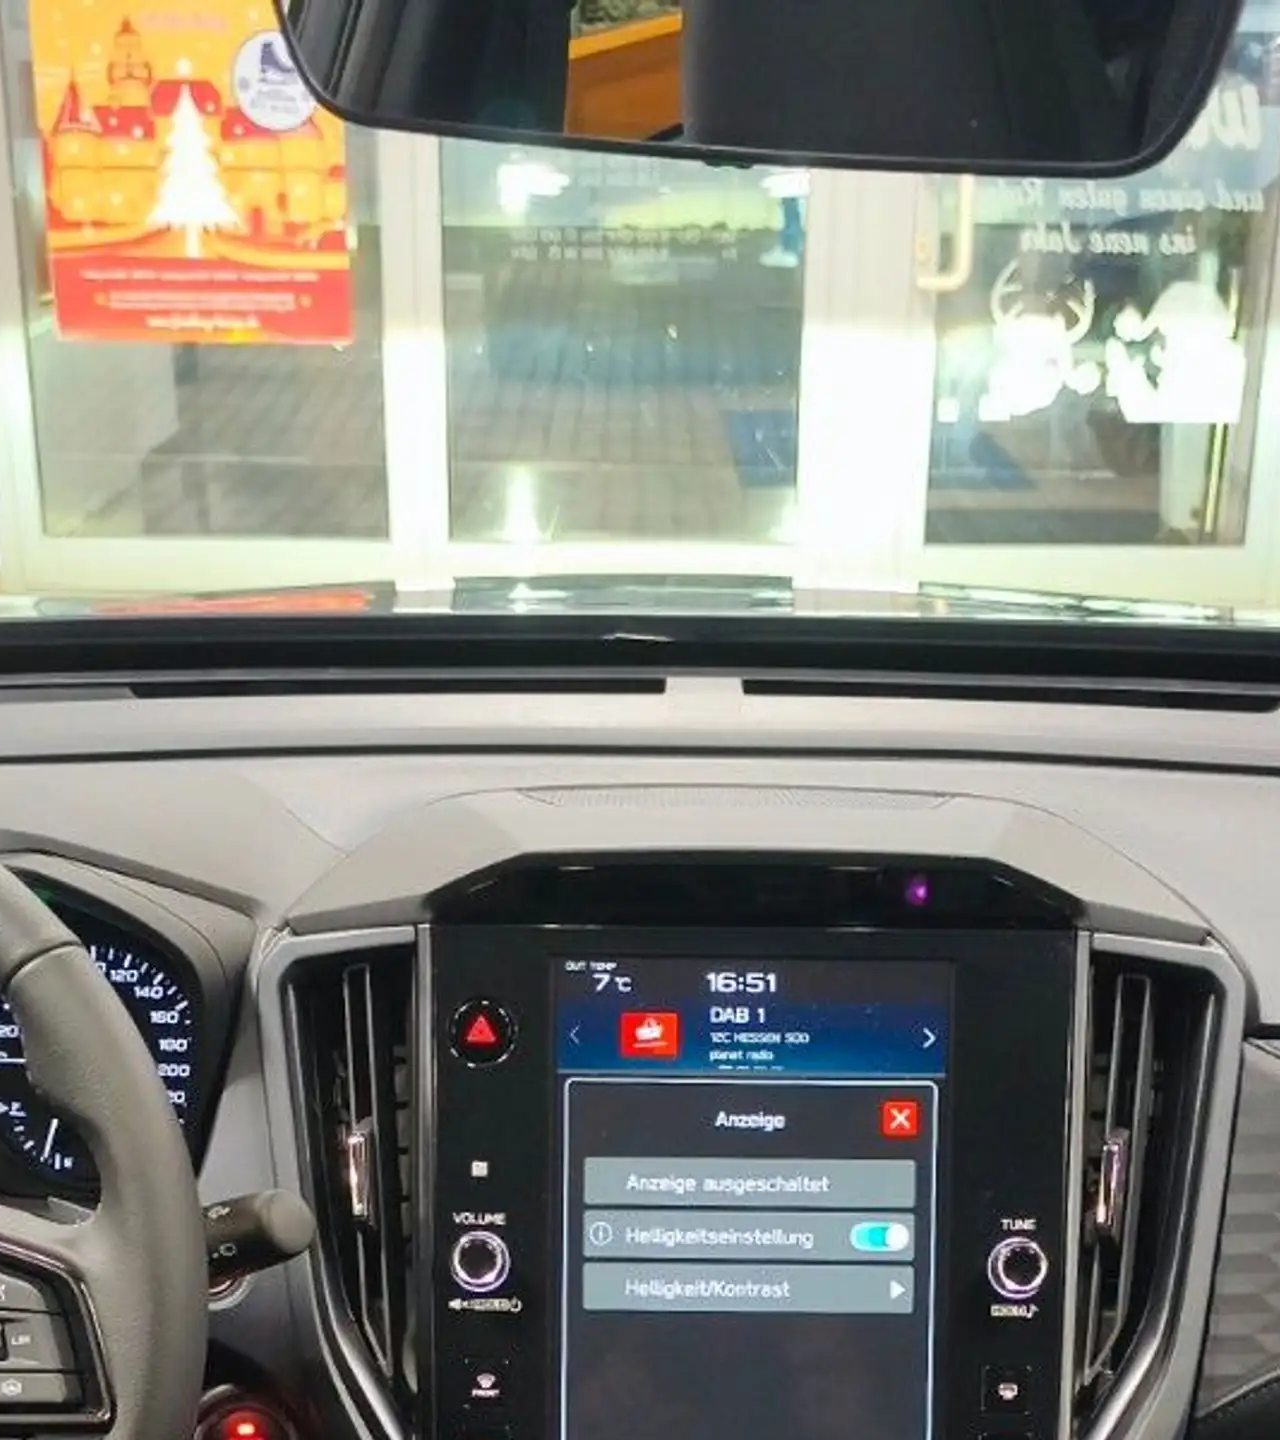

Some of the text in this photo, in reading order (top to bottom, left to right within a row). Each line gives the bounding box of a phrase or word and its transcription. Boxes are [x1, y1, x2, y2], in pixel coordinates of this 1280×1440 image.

[109, 969, 139, 982] 120
[706, 972, 777, 993] 16:51
[134, 986, 164, 999] 140
[710, 1006, 766, 1024] DAB 1
[158, 1064, 190, 1077] 200
[715, 1111, 785, 1131] Anzeige
[625, 1173, 830, 1196] Anzeige ausgeschaltet
[453, 1212, 506, 1225] VOLUME
[1001, 1219, 1036, 1230] TUNE
[625, 1226, 814, 1249] Helligkeitseinstellung
[625, 1278, 790, 1300] Helligkeit/Kontrast
